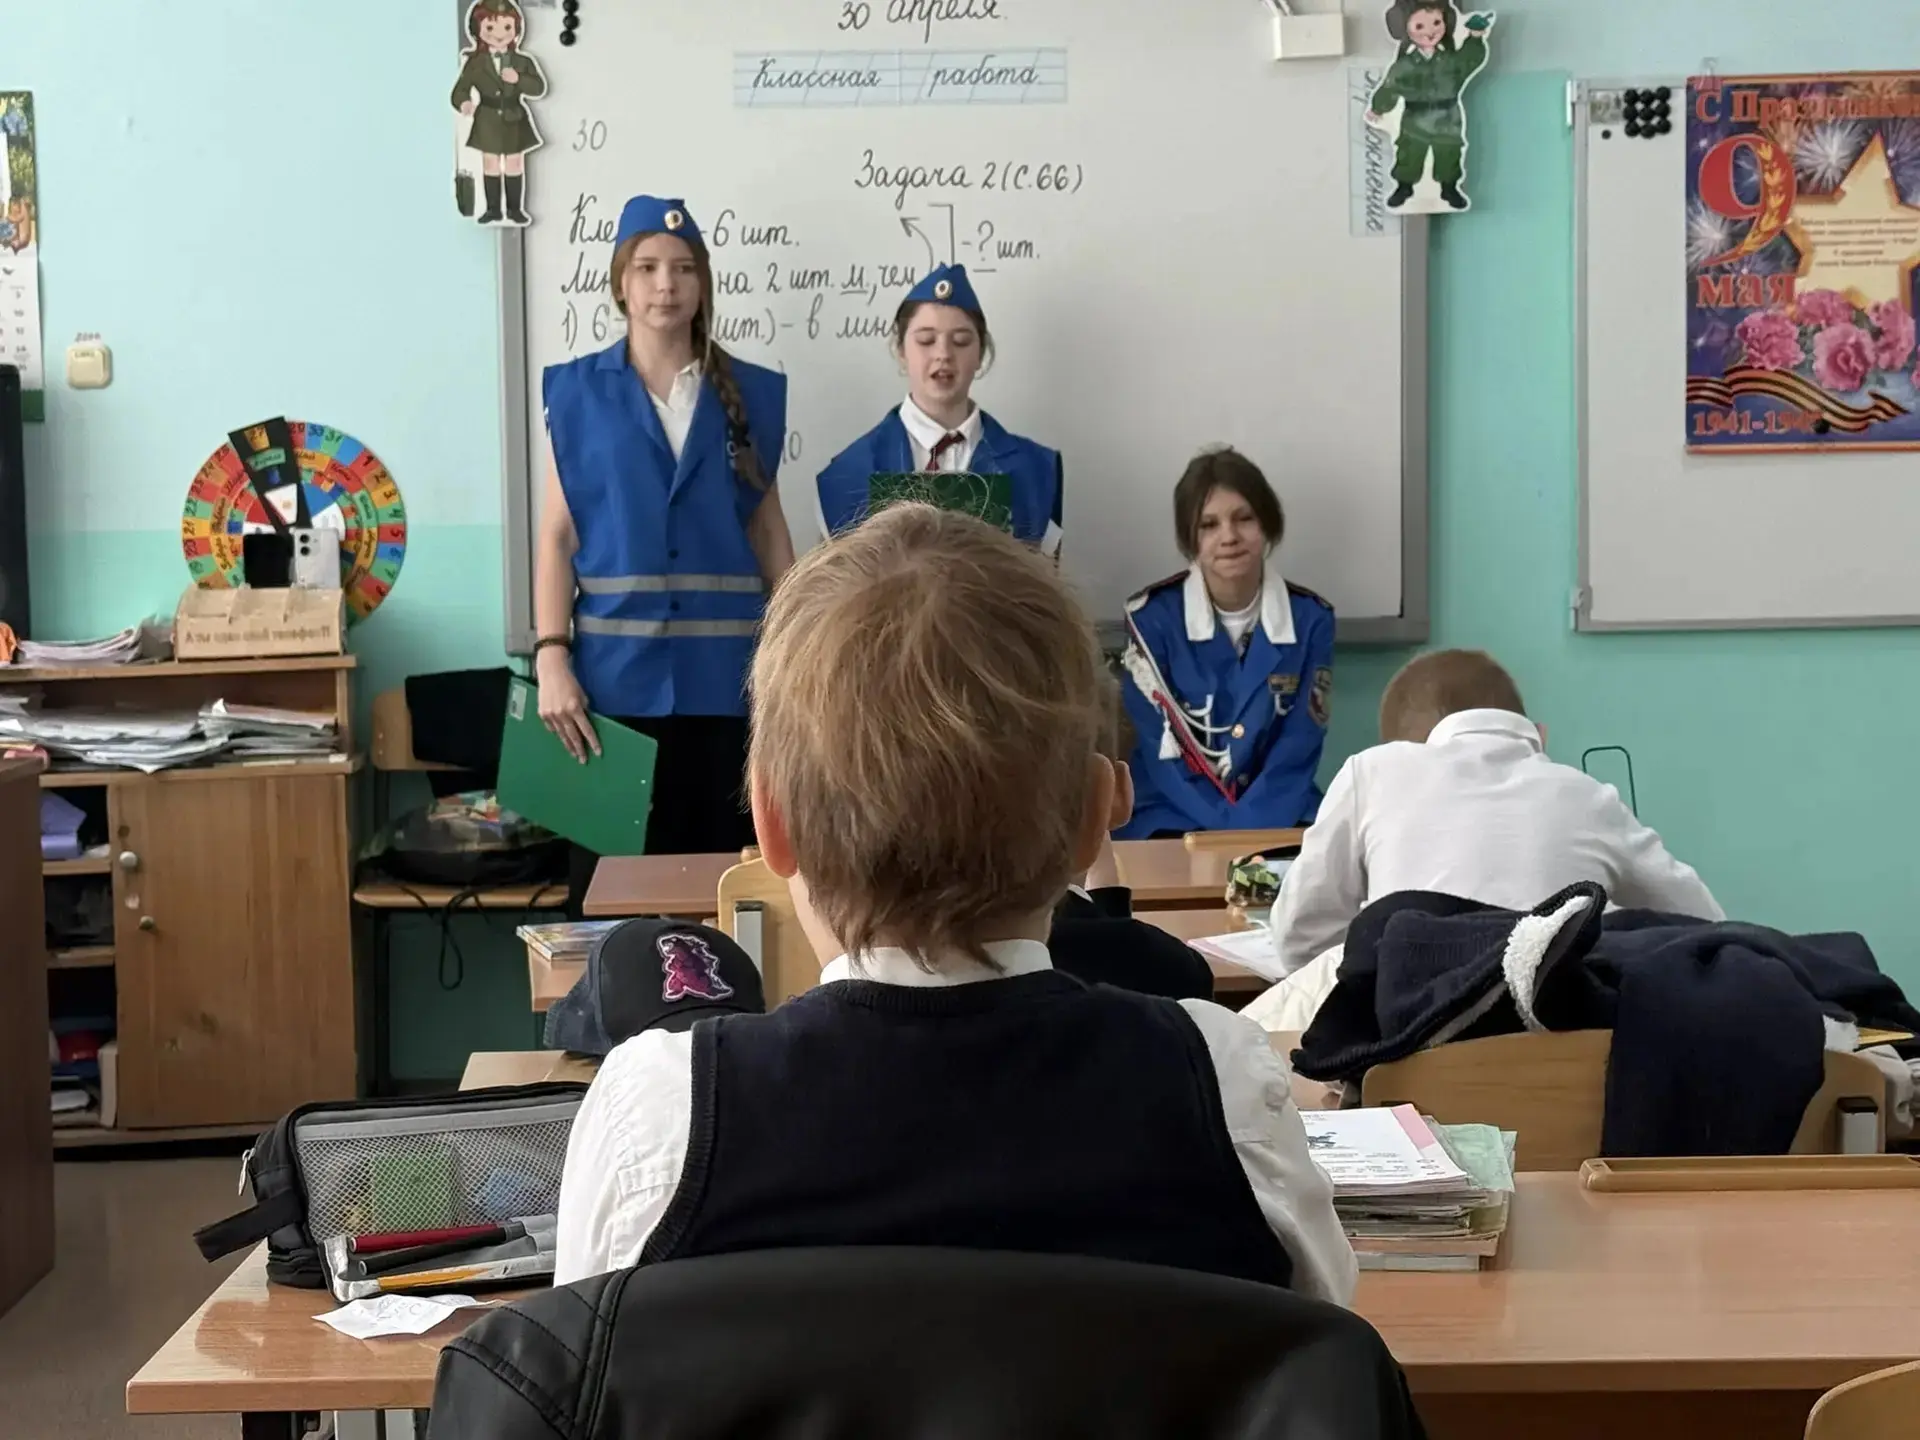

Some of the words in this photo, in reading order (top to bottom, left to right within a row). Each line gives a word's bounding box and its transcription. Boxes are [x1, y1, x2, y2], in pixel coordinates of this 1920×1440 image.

[837, 0, 871, 31] 30
[752, 57, 882, 89] Классная
[1695, 90, 1722, 124] С
[571, 117, 608, 152] 30
[854, 148, 974, 212] Задача
[1698, 133, 1797, 267] 9
[741, 225, 800, 247] шт.
[997, 239, 1041, 260] шт.
[716, 269, 754, 295] на
[766, 261, 783, 294] 2
[789, 268, 835, 291] шт.
[561, 300, 578, 352] 1)
[806, 292, 824, 341] в
